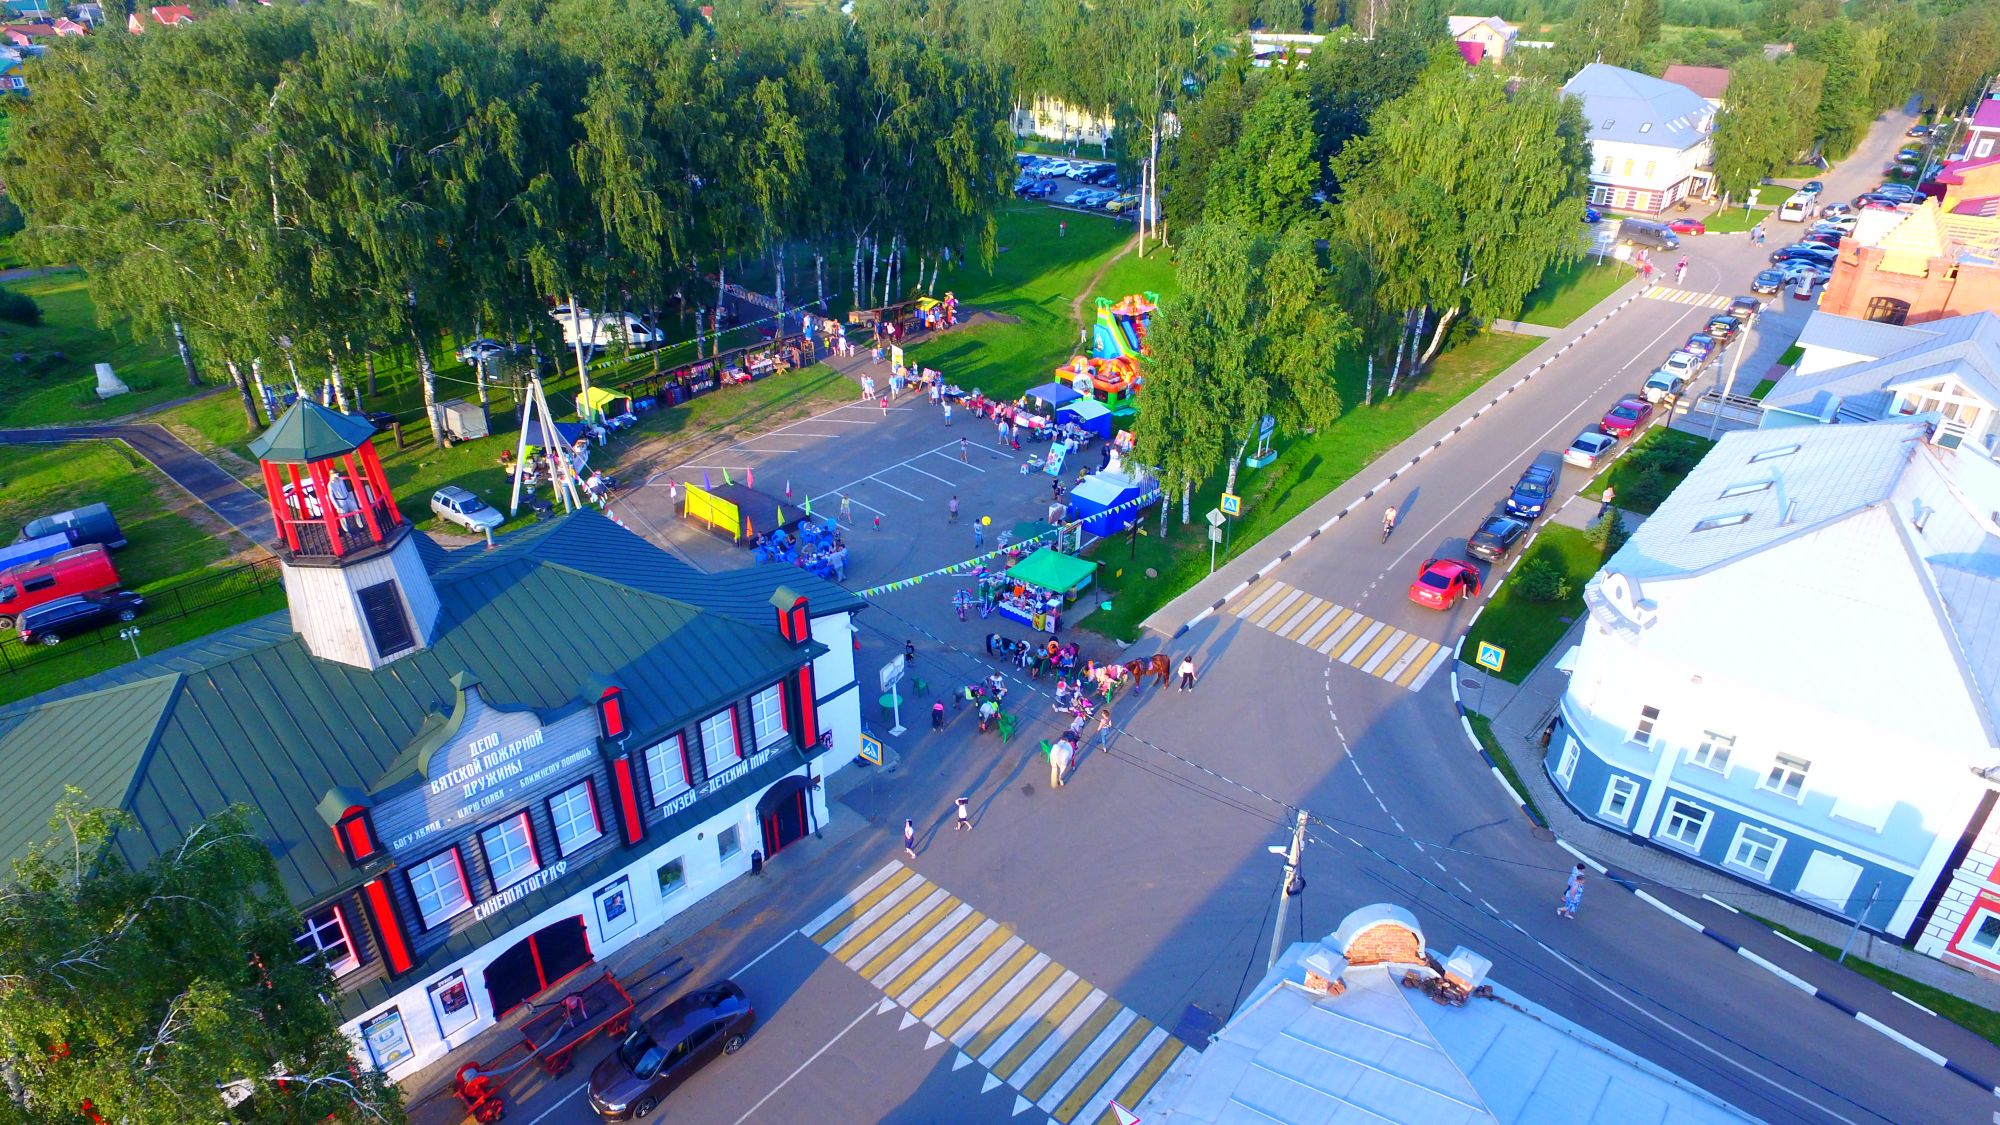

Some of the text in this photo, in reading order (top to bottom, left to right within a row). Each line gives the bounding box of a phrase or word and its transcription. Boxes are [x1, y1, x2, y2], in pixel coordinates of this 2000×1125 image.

[431, 729, 544, 794] ВЯТСКОЙ ПОЖАРНОЙ
[469, 732, 500, 758] ДЕПО
[463, 759, 523, 799] ДРУЖИНЫ
[663, 788, 697, 818] МУЗЕЙ
[394, 831, 413, 850] БОГУ
[473, 861, 567, 921] СИНЕМАТОГРАФ
